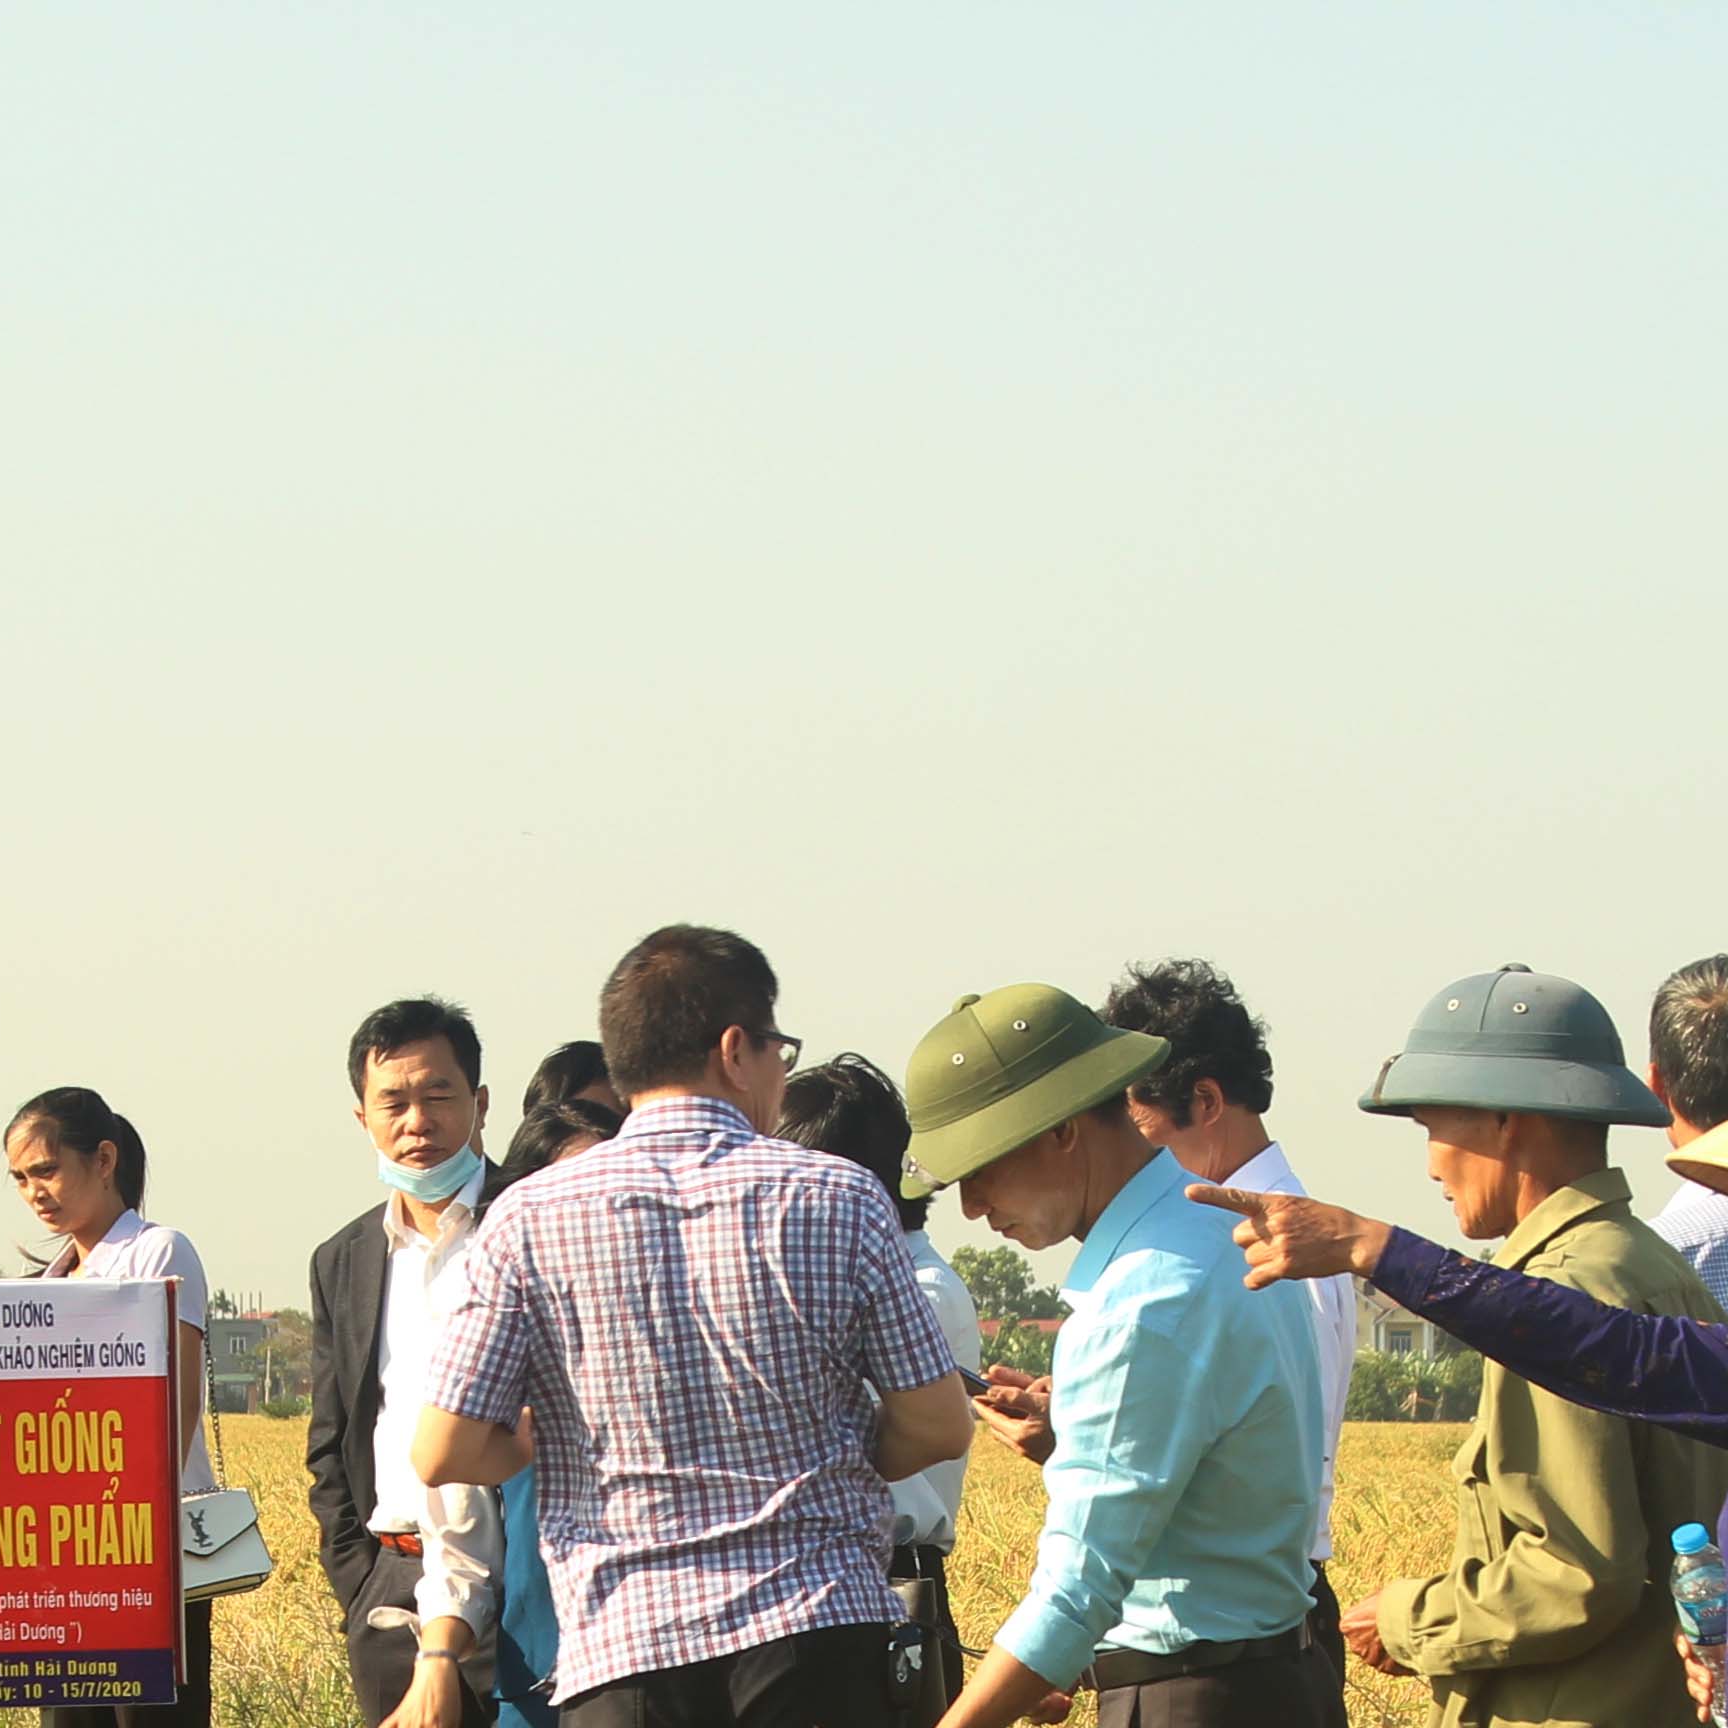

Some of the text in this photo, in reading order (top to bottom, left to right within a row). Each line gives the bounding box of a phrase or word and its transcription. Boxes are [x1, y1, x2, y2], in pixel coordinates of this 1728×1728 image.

[2, 1299, 55, 1328] DƯƠNG
[38, 1338, 95, 1373] NGHIỆM
[99, 1333, 147, 1368] GIỐNG
[14, 1388, 124, 1475] GIỐNG
[49, 1476, 154, 1567] PHẨM
[33, 1586, 65, 1609] triển
[68, 1589, 118, 1612] thương
[122, 1588, 152, 1610] hiệu
[19, 1621, 65, 1644] Dương
[35, 1658, 61, 1676] Hải
[67, 1660, 118, 1677] Dương
[24, 1683, 42, 1699] 10
[62, 1681, 141, 1698] 15/7/2020
